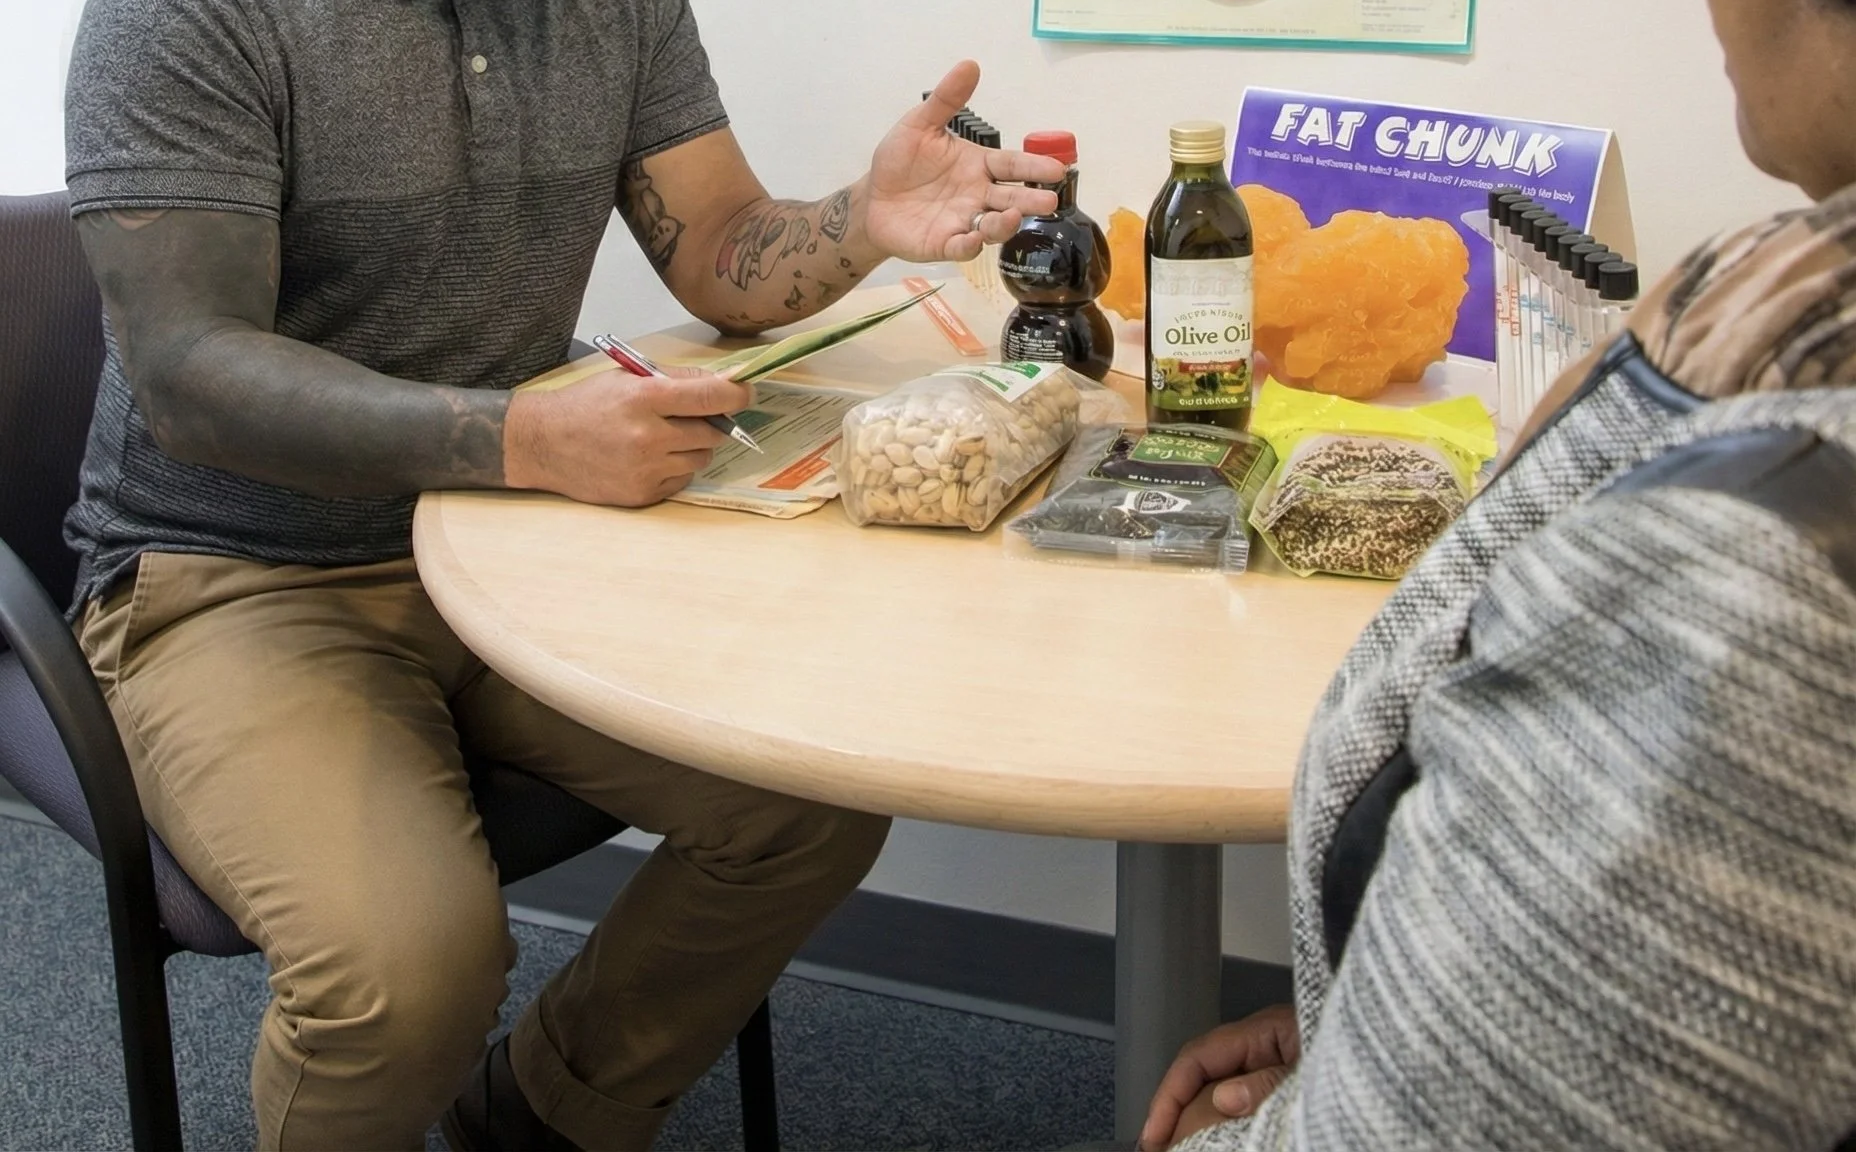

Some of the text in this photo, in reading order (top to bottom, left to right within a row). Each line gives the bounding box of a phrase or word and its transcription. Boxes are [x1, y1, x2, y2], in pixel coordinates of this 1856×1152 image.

[1270, 103, 1367, 152] FAT
[1375, 116, 1564, 178] CHUNK
[1165, 322, 1251, 346] Olive Oil
